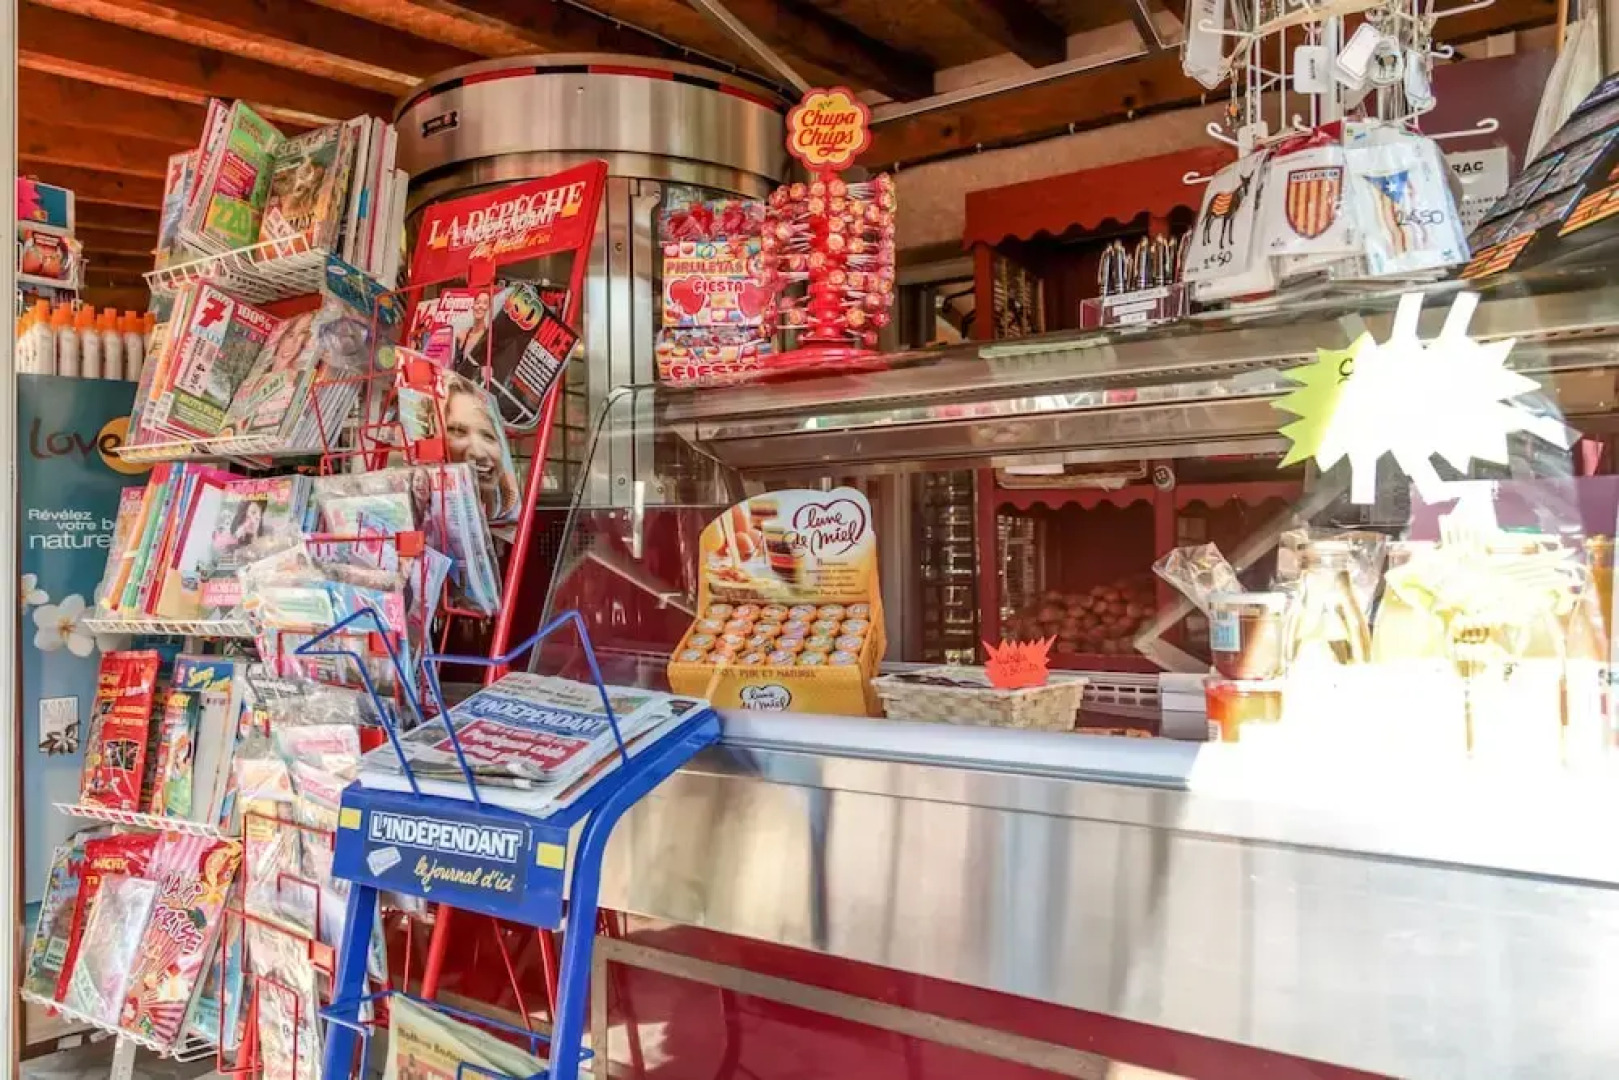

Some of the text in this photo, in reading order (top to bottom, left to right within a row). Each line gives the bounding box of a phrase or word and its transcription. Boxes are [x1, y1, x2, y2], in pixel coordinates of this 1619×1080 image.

[801, 109, 857, 131] Chupa
[798, 127, 855, 157] Chups
[427, 216, 460, 247] LA
[693, 280, 744, 293] FIESTA
[236, 303, 273, 332] 100%
[28, 508, 93, 521] Révélez
[56, 519, 97, 531] votre
[414, 854, 516, 893] le journal d'ici
